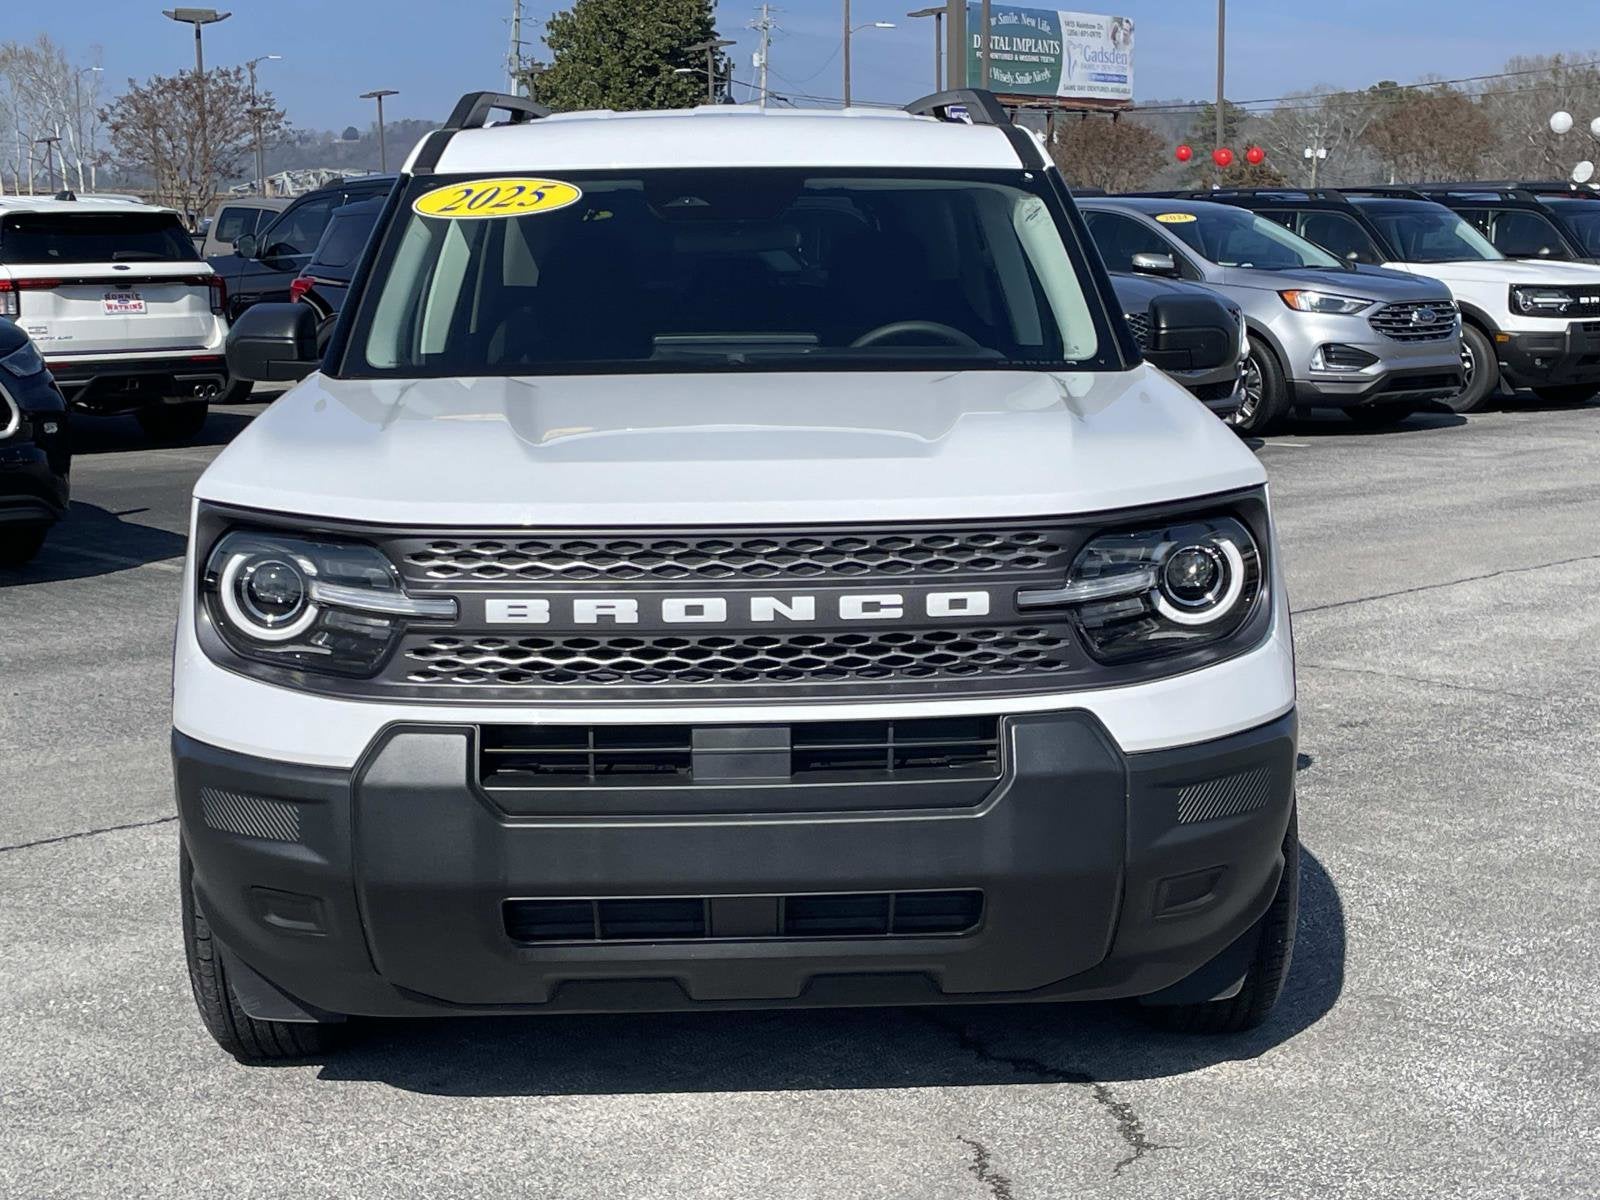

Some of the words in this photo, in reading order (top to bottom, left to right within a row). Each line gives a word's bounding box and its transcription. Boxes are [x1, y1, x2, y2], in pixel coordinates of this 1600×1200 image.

[1013, 37, 1060, 54] IMPLANTS
[1083, 44, 1128, 65] Gadsden
[437, 185, 557, 213] 2025
[104, 292, 141, 301] RONNIE
[105, 302, 143, 311] WATKINS
[485, 590, 990, 624] BRONCO
